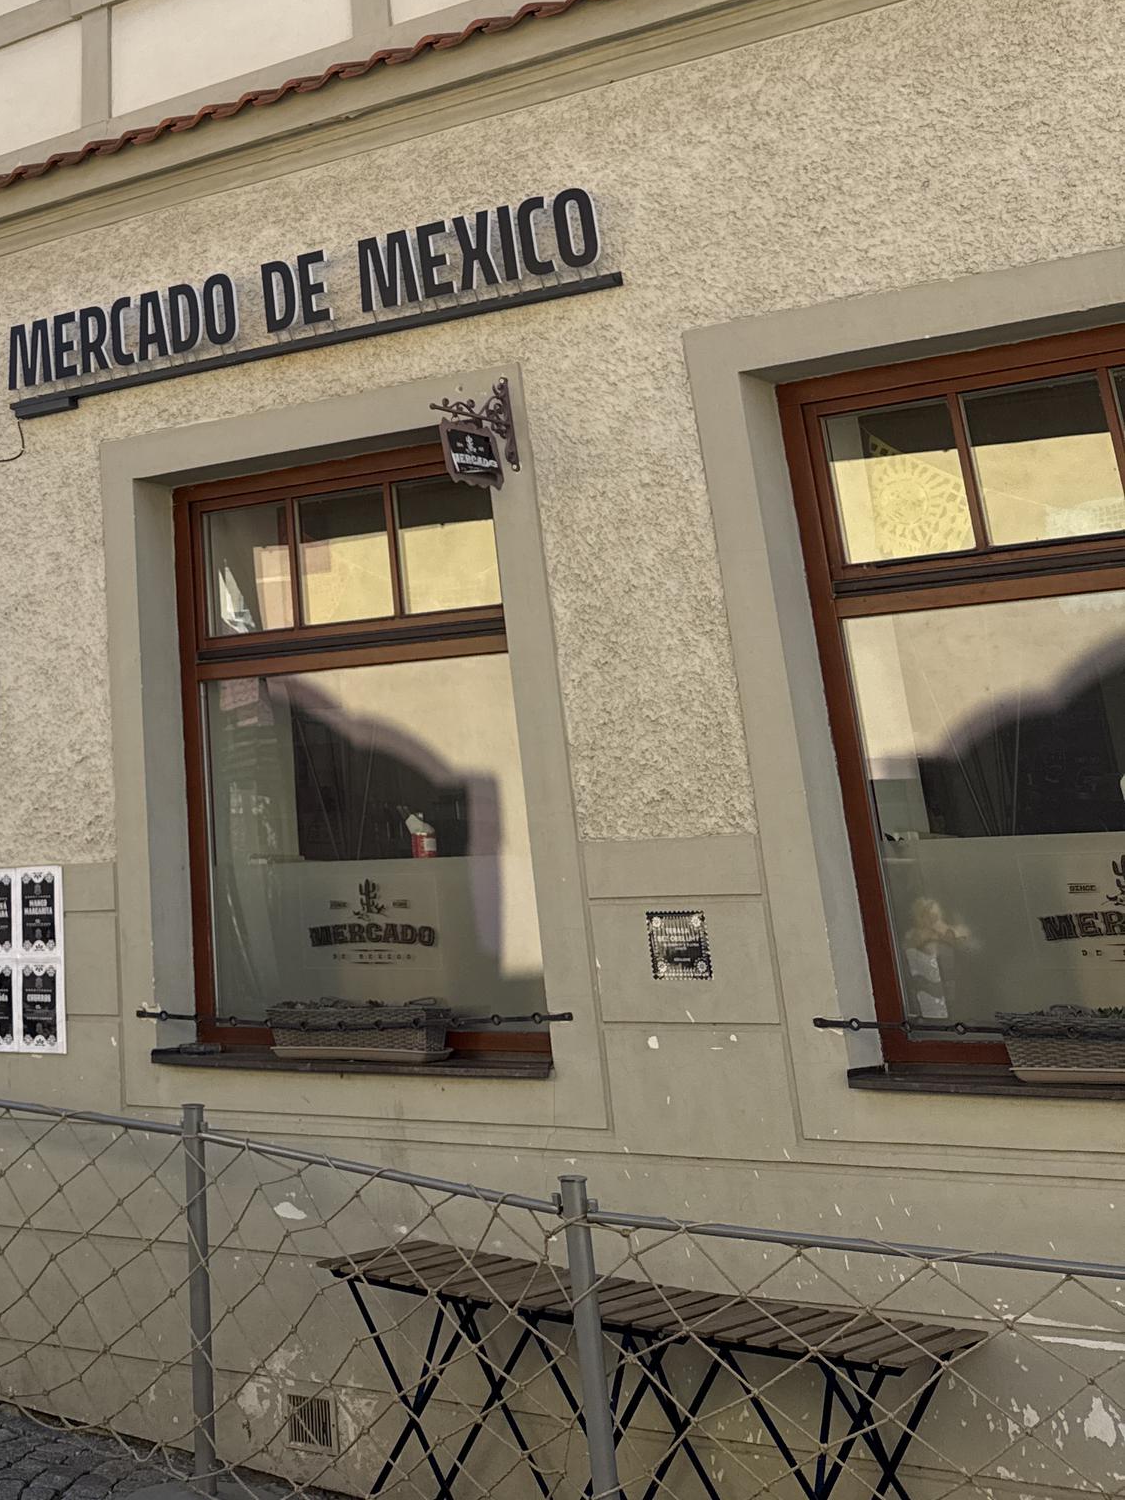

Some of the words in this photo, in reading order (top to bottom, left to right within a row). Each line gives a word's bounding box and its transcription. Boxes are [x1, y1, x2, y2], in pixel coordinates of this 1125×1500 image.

[8, 273, 237, 390] MERCADO
[261, 250, 332, 333] DE
[357, 187, 601, 313] MEXICO
[308, 922, 436, 947] MERCADO
